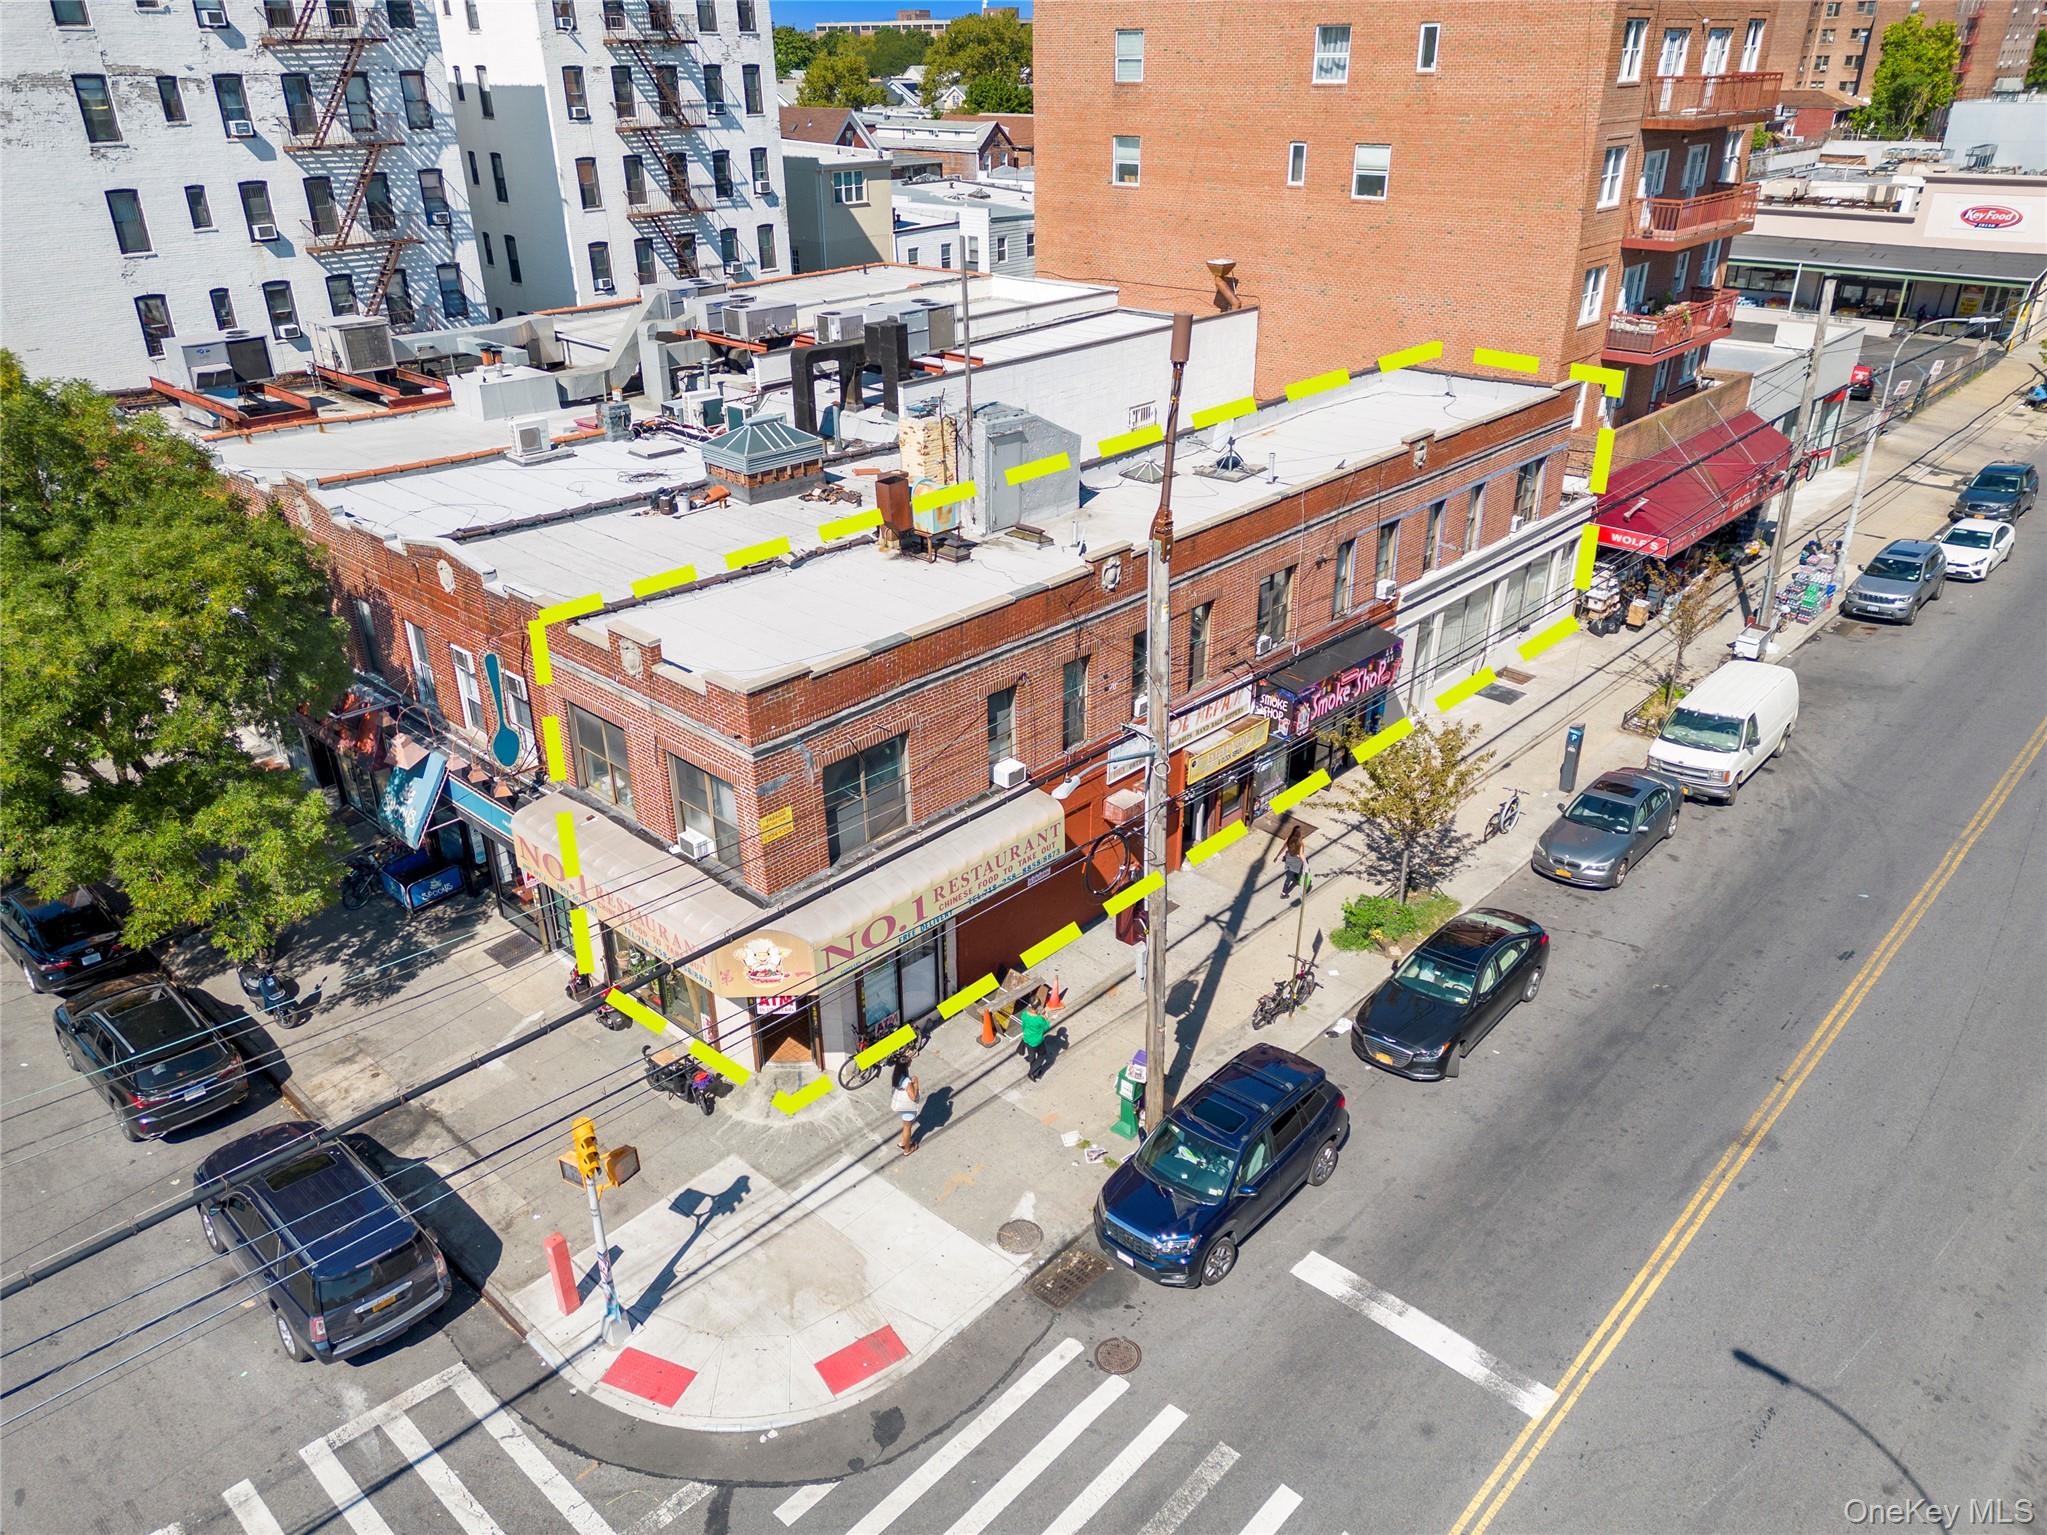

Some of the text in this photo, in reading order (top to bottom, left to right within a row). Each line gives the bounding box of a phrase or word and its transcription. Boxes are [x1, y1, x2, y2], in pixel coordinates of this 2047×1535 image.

[1611, 532, 1659, 551] WOLF'S
[1263, 704, 1284, 719] SHOP
[938, 841, 1056, 911] CHINESE FOOD TO TAKE OUT
[821, 822, 1061, 970] NO.1 RESTAURANT
[898, 929, 916, 945] FREE
[919, 909, 954, 932] DELIVERY
[759, 995, 794, 1007] ATM
